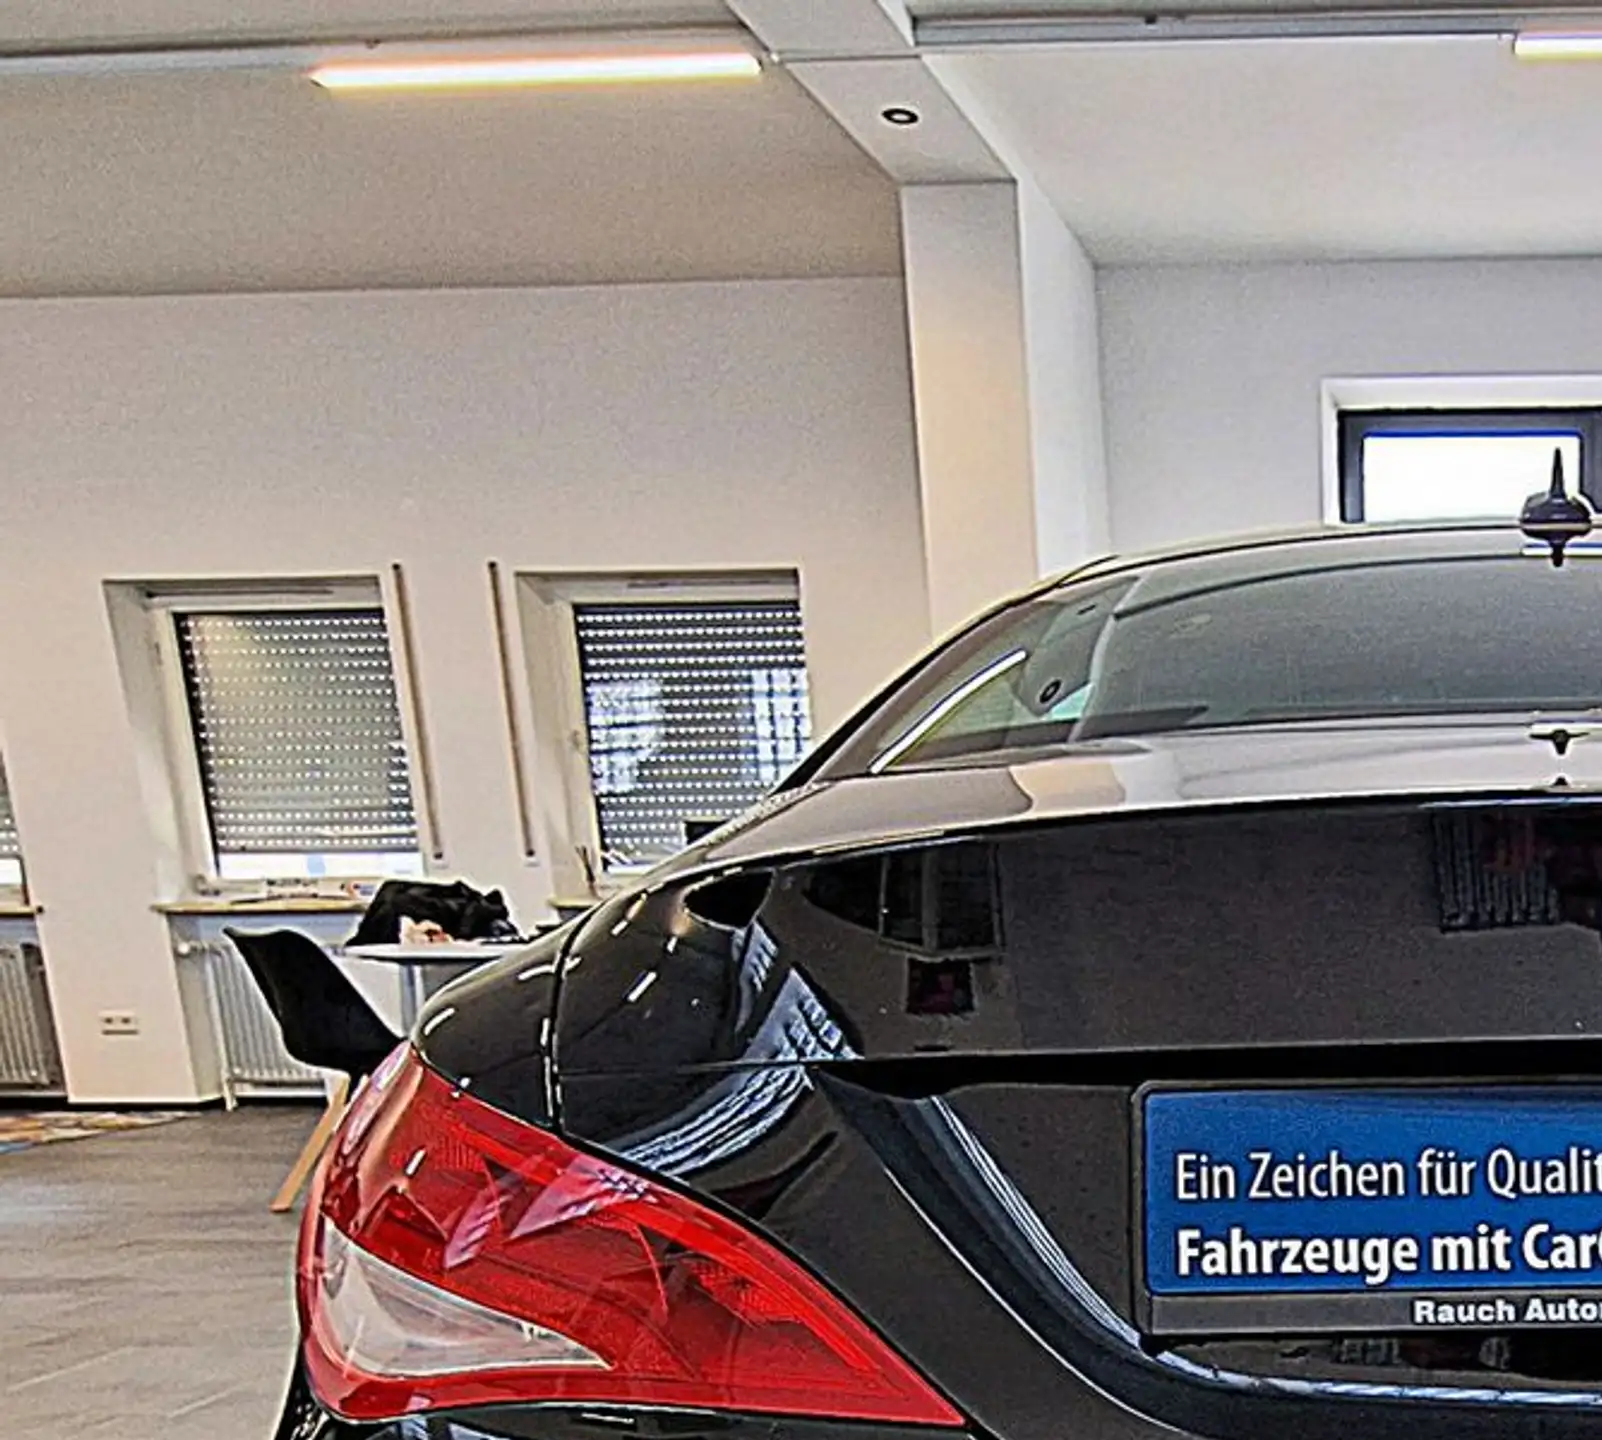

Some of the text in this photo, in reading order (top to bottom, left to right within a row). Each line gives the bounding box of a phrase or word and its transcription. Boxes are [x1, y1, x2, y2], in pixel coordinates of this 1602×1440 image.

[1177, 1153, 1236, 1200] Ein
[1248, 1150, 1406, 1199] Zeichen
[1416, 1147, 1478, 1196] für
[1177, 1227, 1418, 1286] Fahrzeuge
[1432, 1223, 1512, 1272] mit
[1413, 1298, 1516, 1324] Rauch
